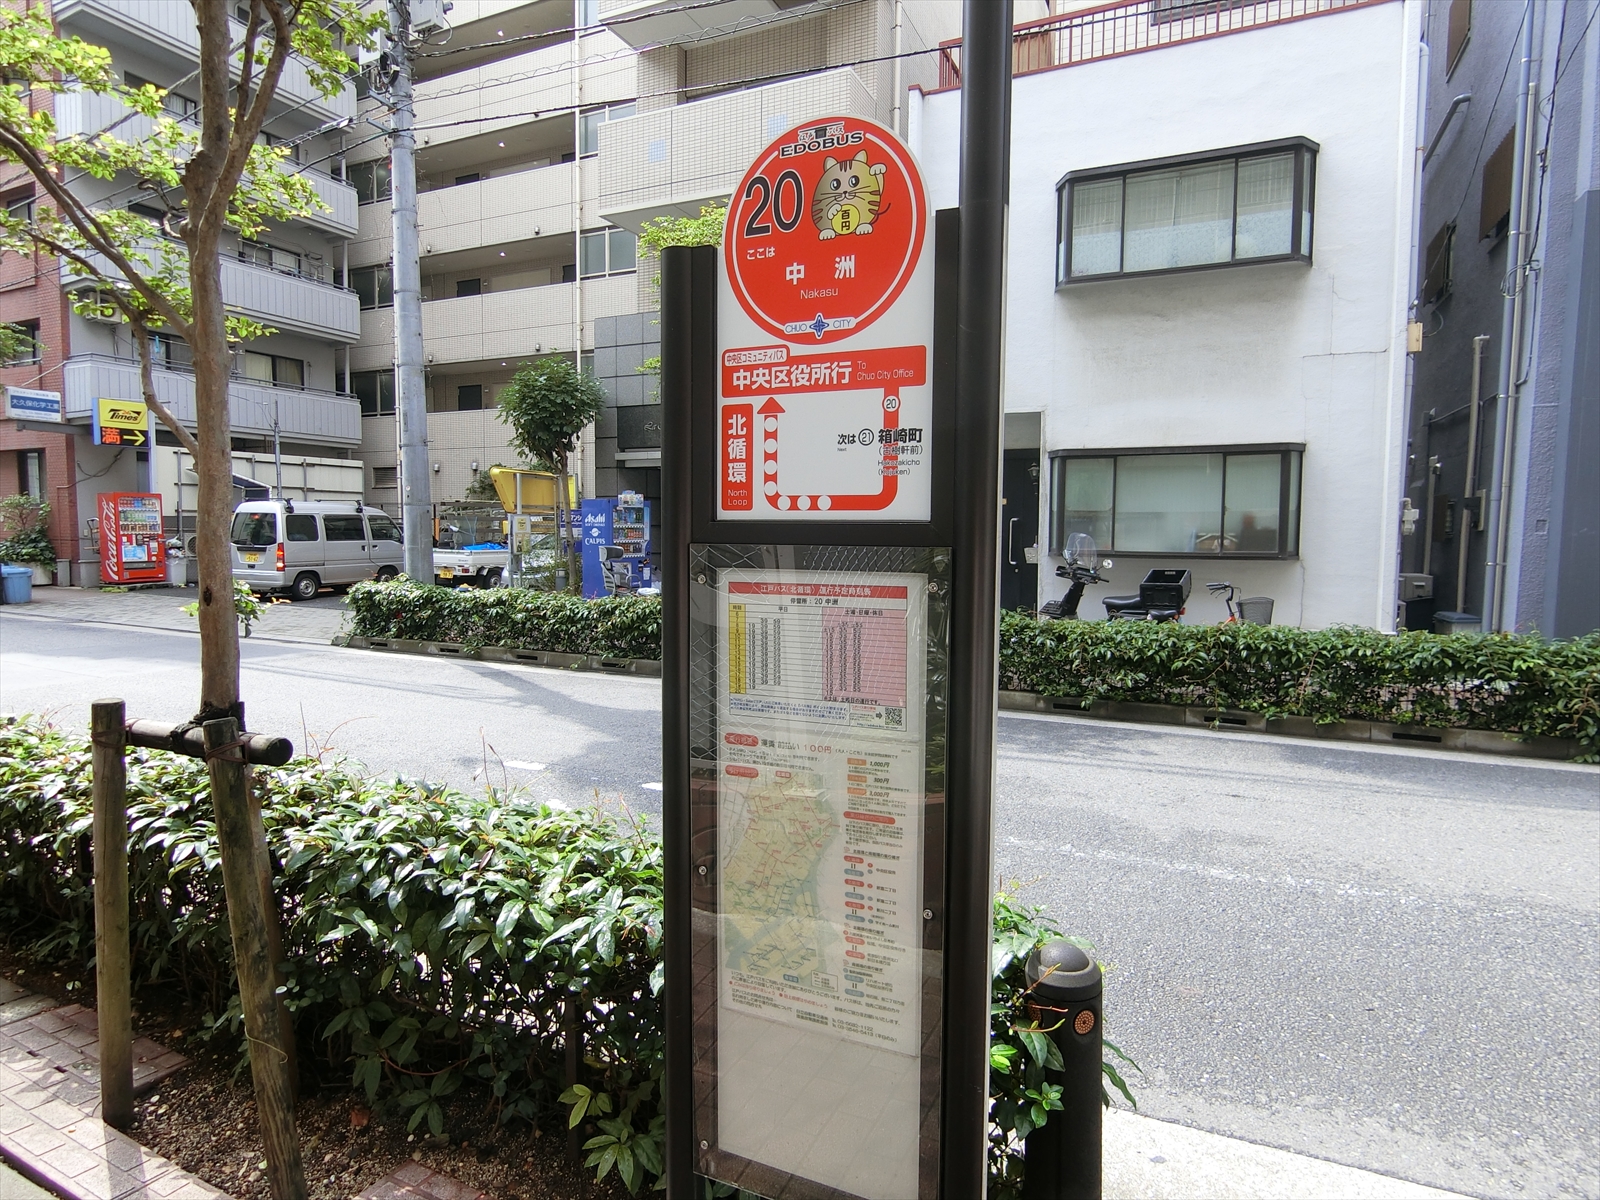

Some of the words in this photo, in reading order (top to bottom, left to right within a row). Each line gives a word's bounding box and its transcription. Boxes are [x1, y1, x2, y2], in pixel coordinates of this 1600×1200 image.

[781, 132, 863, 157] EDOBUS
[744, 170, 803, 237] 20
[841, 209, 851, 231] 百円
[747, 247, 775, 260] ここは
[801, 288, 838, 299] Nakasu
[785, 323, 807, 333] CHUO
[833, 319, 852, 328] CITY
[726, 350, 784, 365] 中央区コミュニティバス
[857, 361, 866, 370] To
[733, 361, 852, 391] 中央区役所行
[857, 371, 875, 381] Chuo
[877, 370, 891, 381] City
[893, 369, 914, 379] Office
[886, 398, 897, 409] 20
[108, 409, 142, 421] Times
[102, 428, 120, 444] 満
[837, 434, 856, 445] 次は
[878, 428, 923, 444] 箱崎町
[728, 413, 747, 483] 北循環
[728, 489, 748, 497] North
[728, 499, 748, 507] Loop
[585, 513, 605, 523] Asahi
